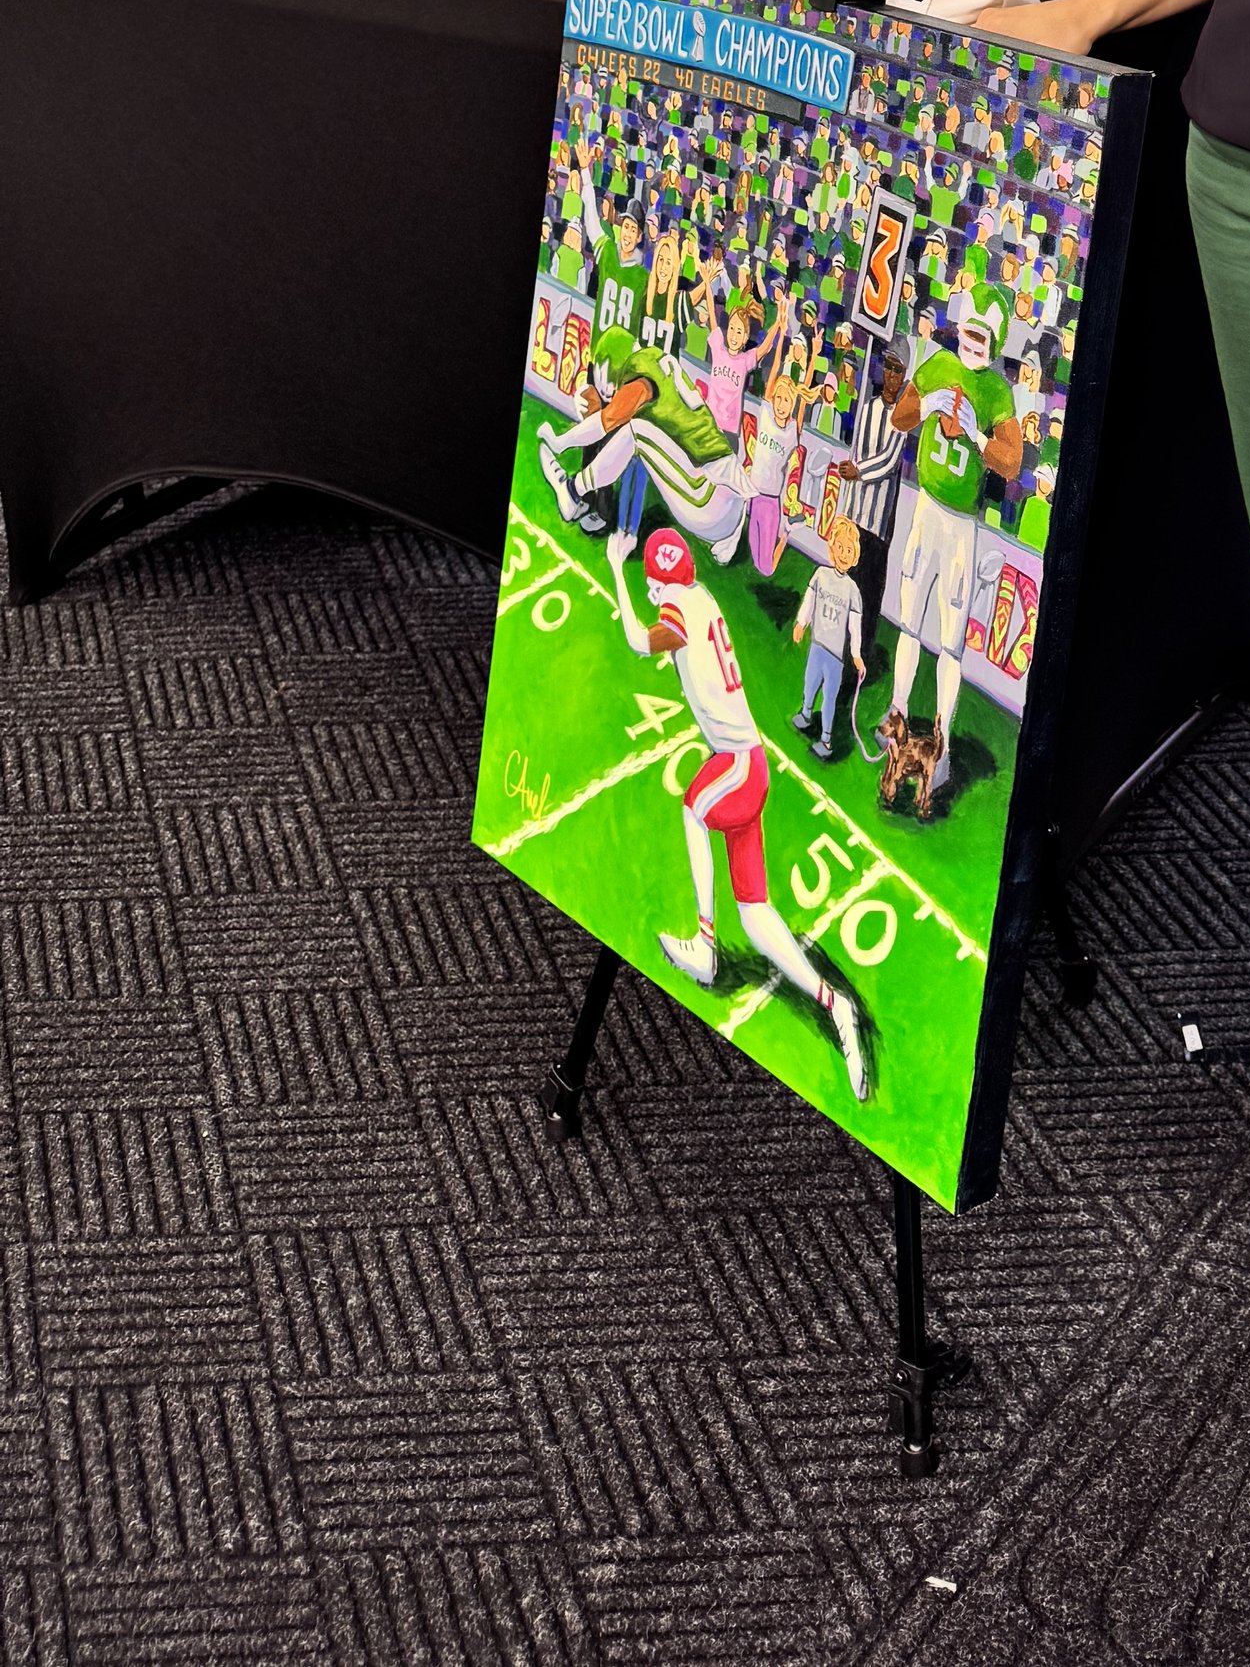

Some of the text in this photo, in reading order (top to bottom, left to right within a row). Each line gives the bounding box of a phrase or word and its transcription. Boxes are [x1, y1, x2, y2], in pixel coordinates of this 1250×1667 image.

[577, 44, 766, 111] CHIEFS 22 40 EAGLES
[715, 18, 843, 102] CHAMPIONS
[863, 213, 904, 320] 3
[600, 278, 634, 331] 68
[713, 366, 741, 387] EAGLES
[822, 604, 841, 624] LIX
